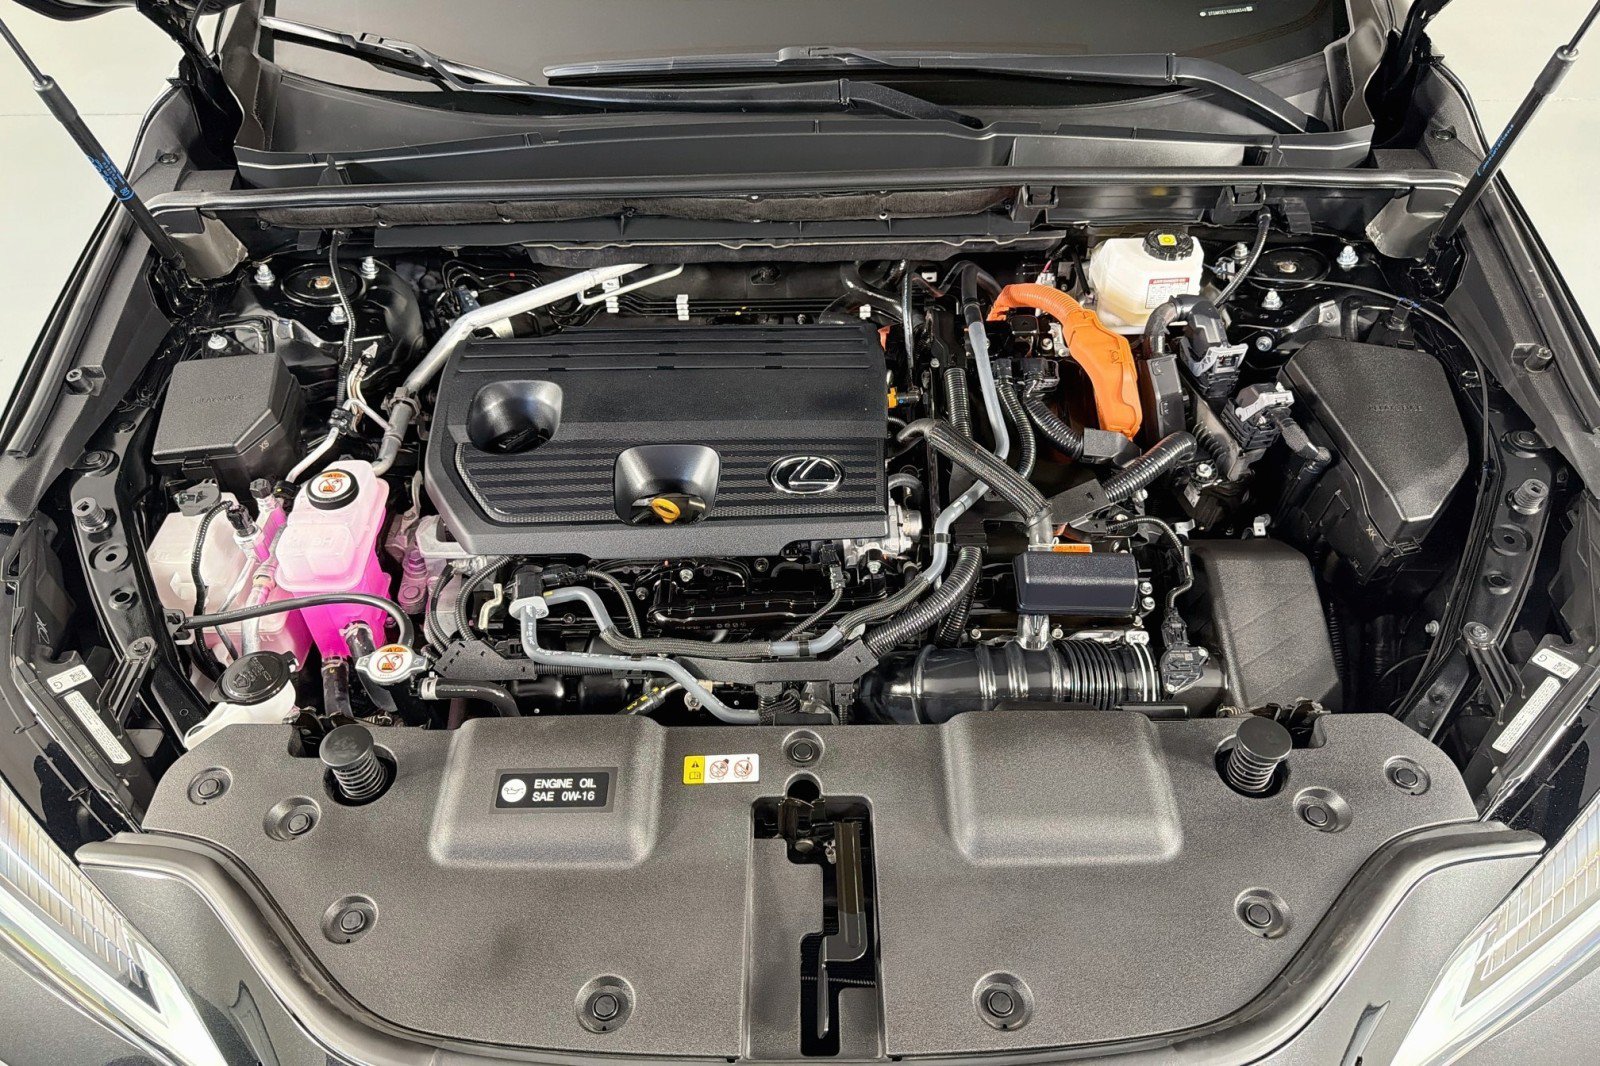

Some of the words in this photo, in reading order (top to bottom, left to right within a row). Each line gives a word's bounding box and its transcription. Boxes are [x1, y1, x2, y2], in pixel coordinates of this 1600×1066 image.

[534, 778, 573, 789] ENGINE
[579, 777, 596, 788] OIL
[532, 791, 555, 802] SAE
[561, 791, 596, 801] 0W-16
